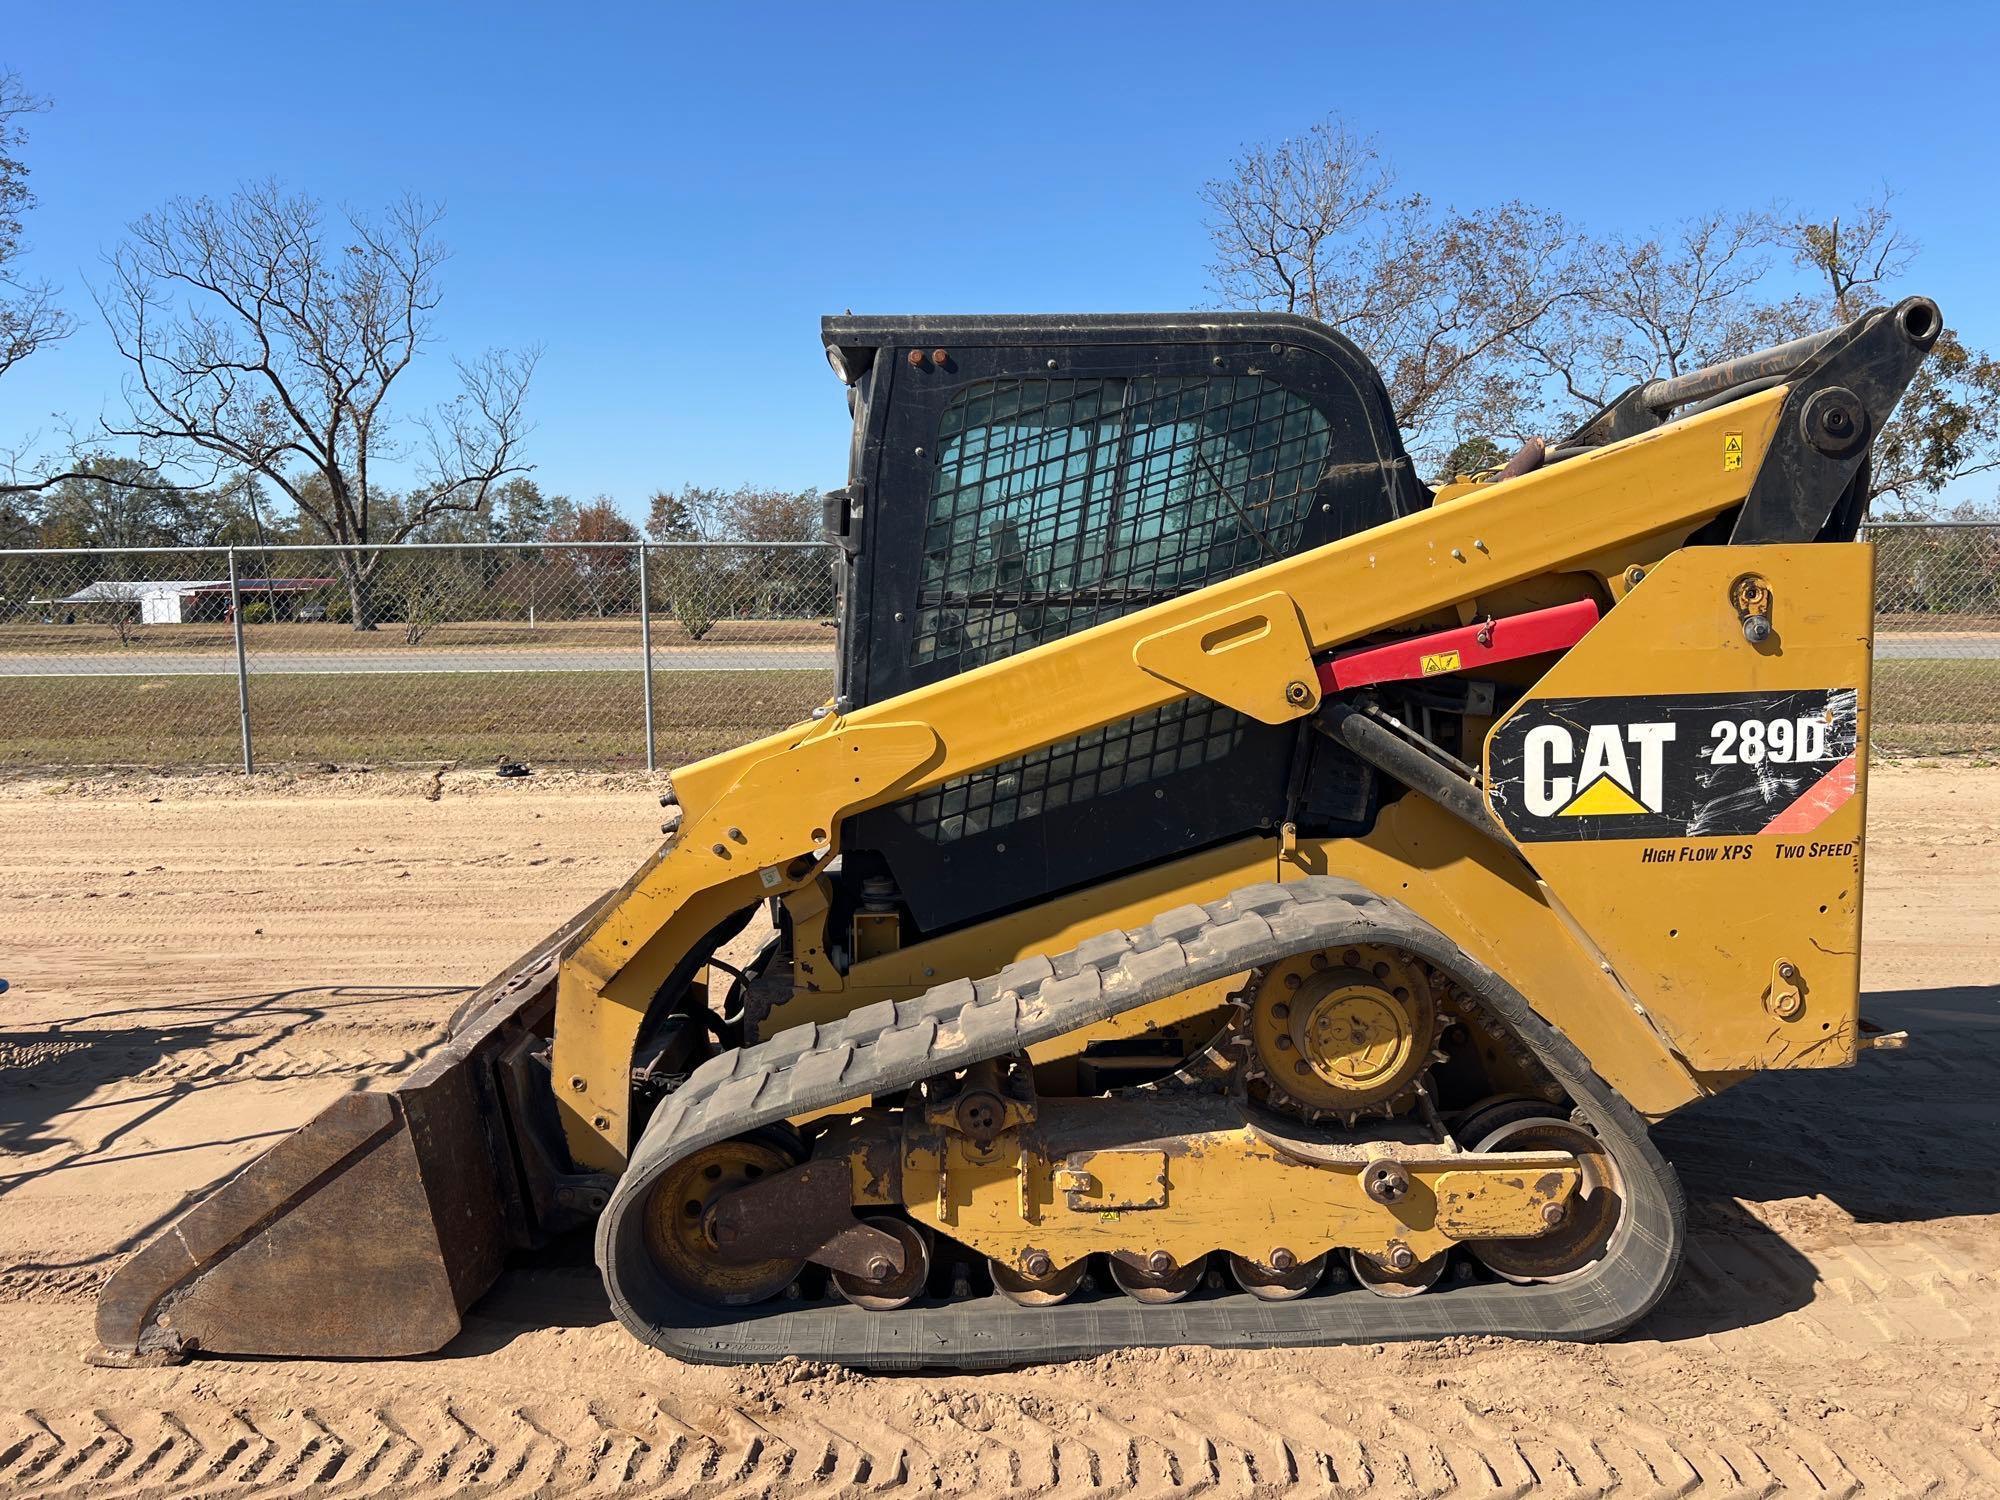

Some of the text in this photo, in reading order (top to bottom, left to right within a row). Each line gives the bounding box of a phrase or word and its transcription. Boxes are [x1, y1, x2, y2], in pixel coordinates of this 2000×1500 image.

[1710, 718, 1824, 765] 289D
[1523, 722, 1676, 817] CAT
[1721, 844, 1753, 860] XPS
